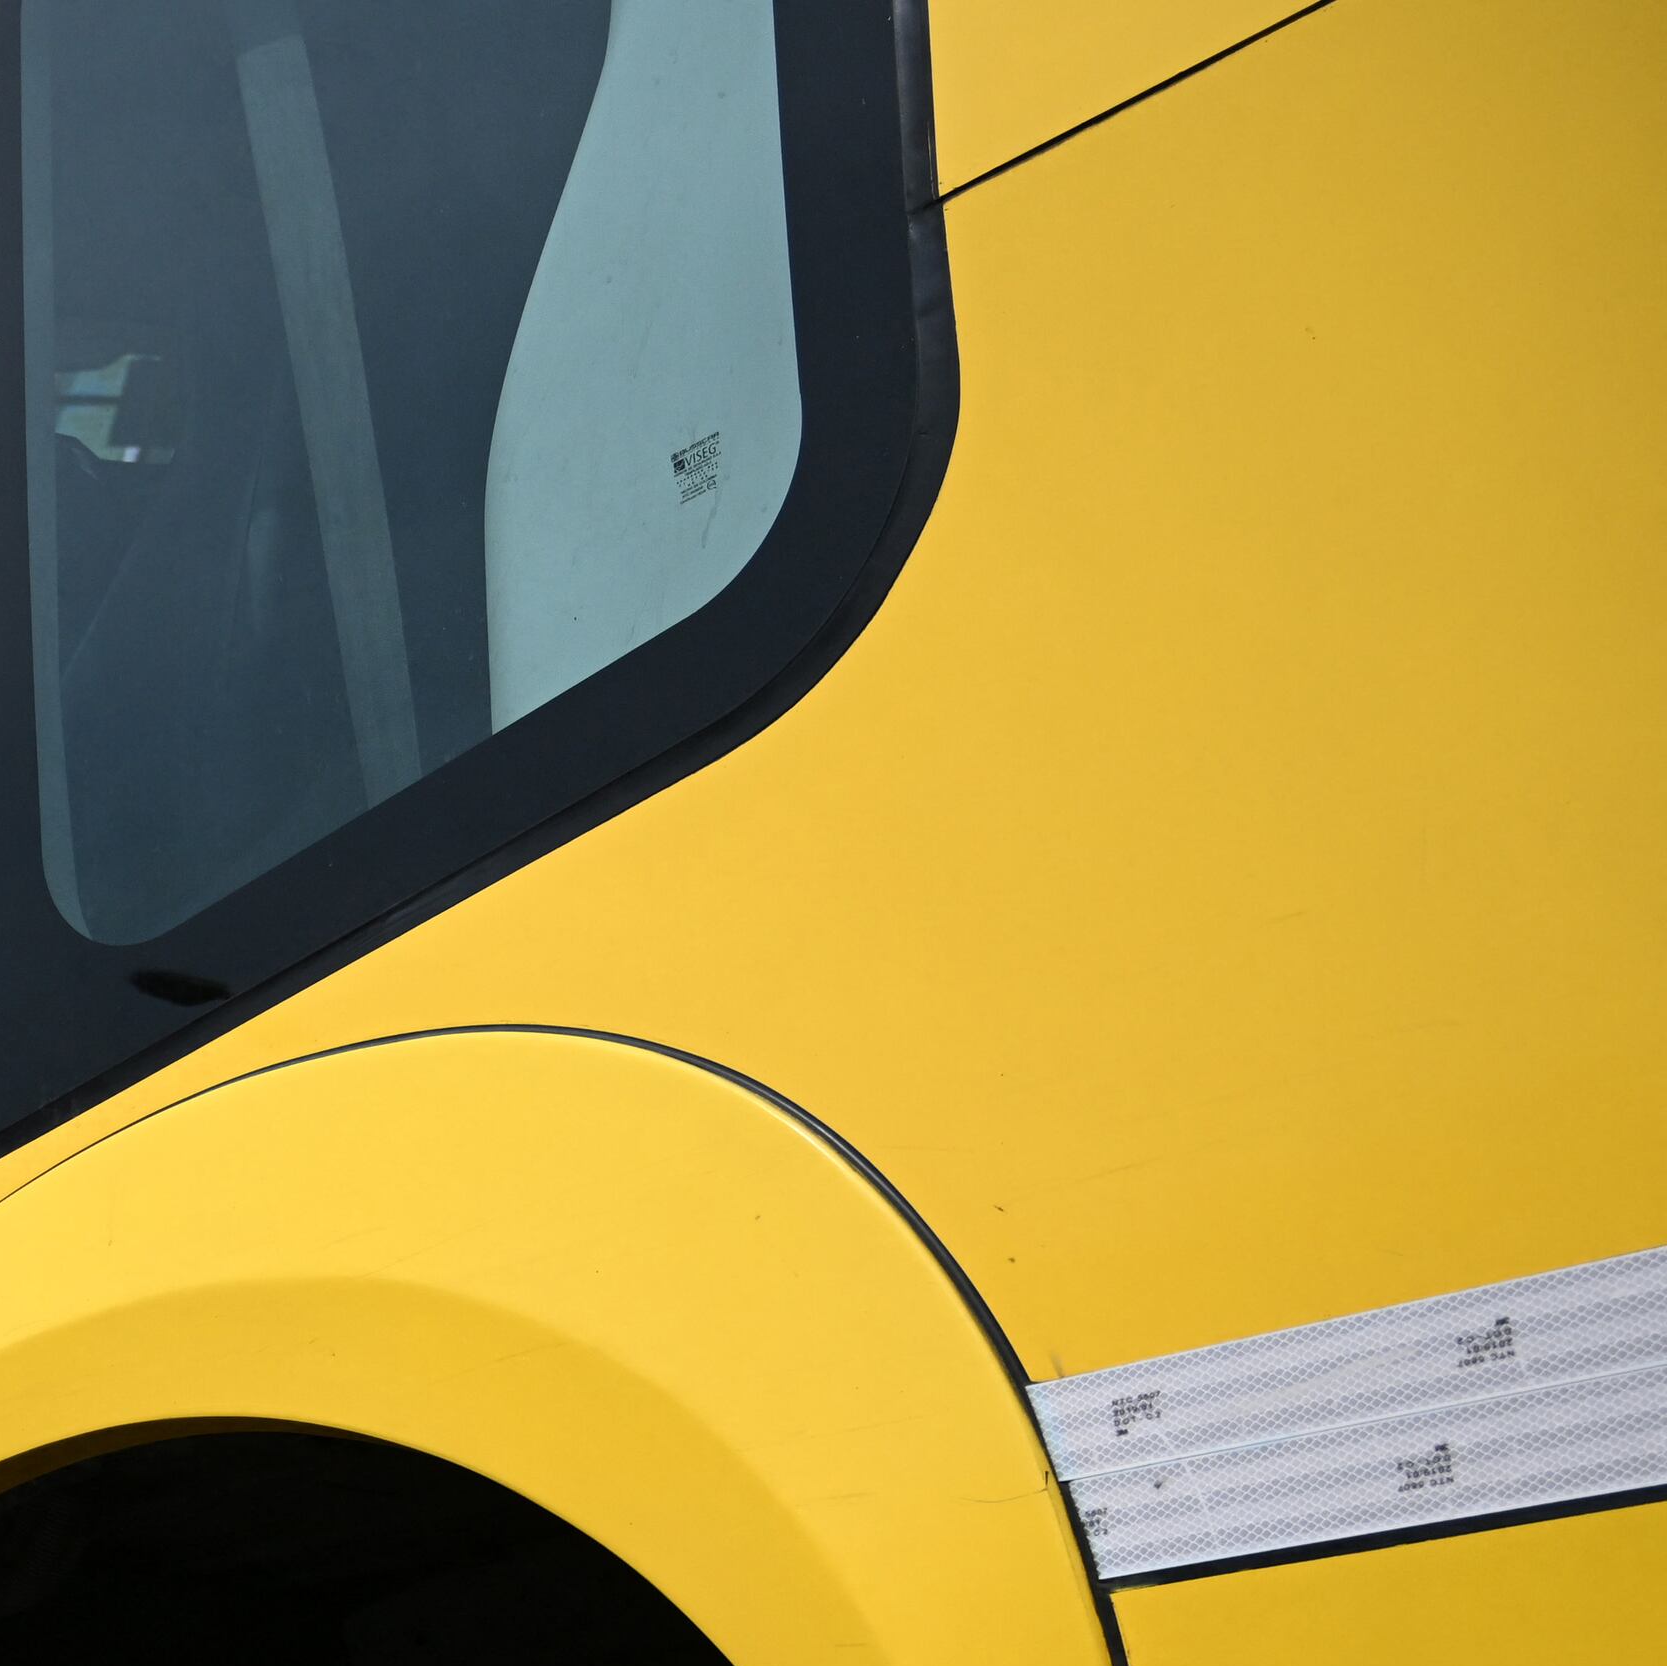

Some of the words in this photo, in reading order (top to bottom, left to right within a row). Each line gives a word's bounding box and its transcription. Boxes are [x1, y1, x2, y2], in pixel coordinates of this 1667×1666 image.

[684, 441, 718, 466] VISEG
[1489, 1349, 1516, 1361] NTC
[1111, 1396, 1134, 1406] NTC
[1428, 1476, 1455, 1487] NTC
